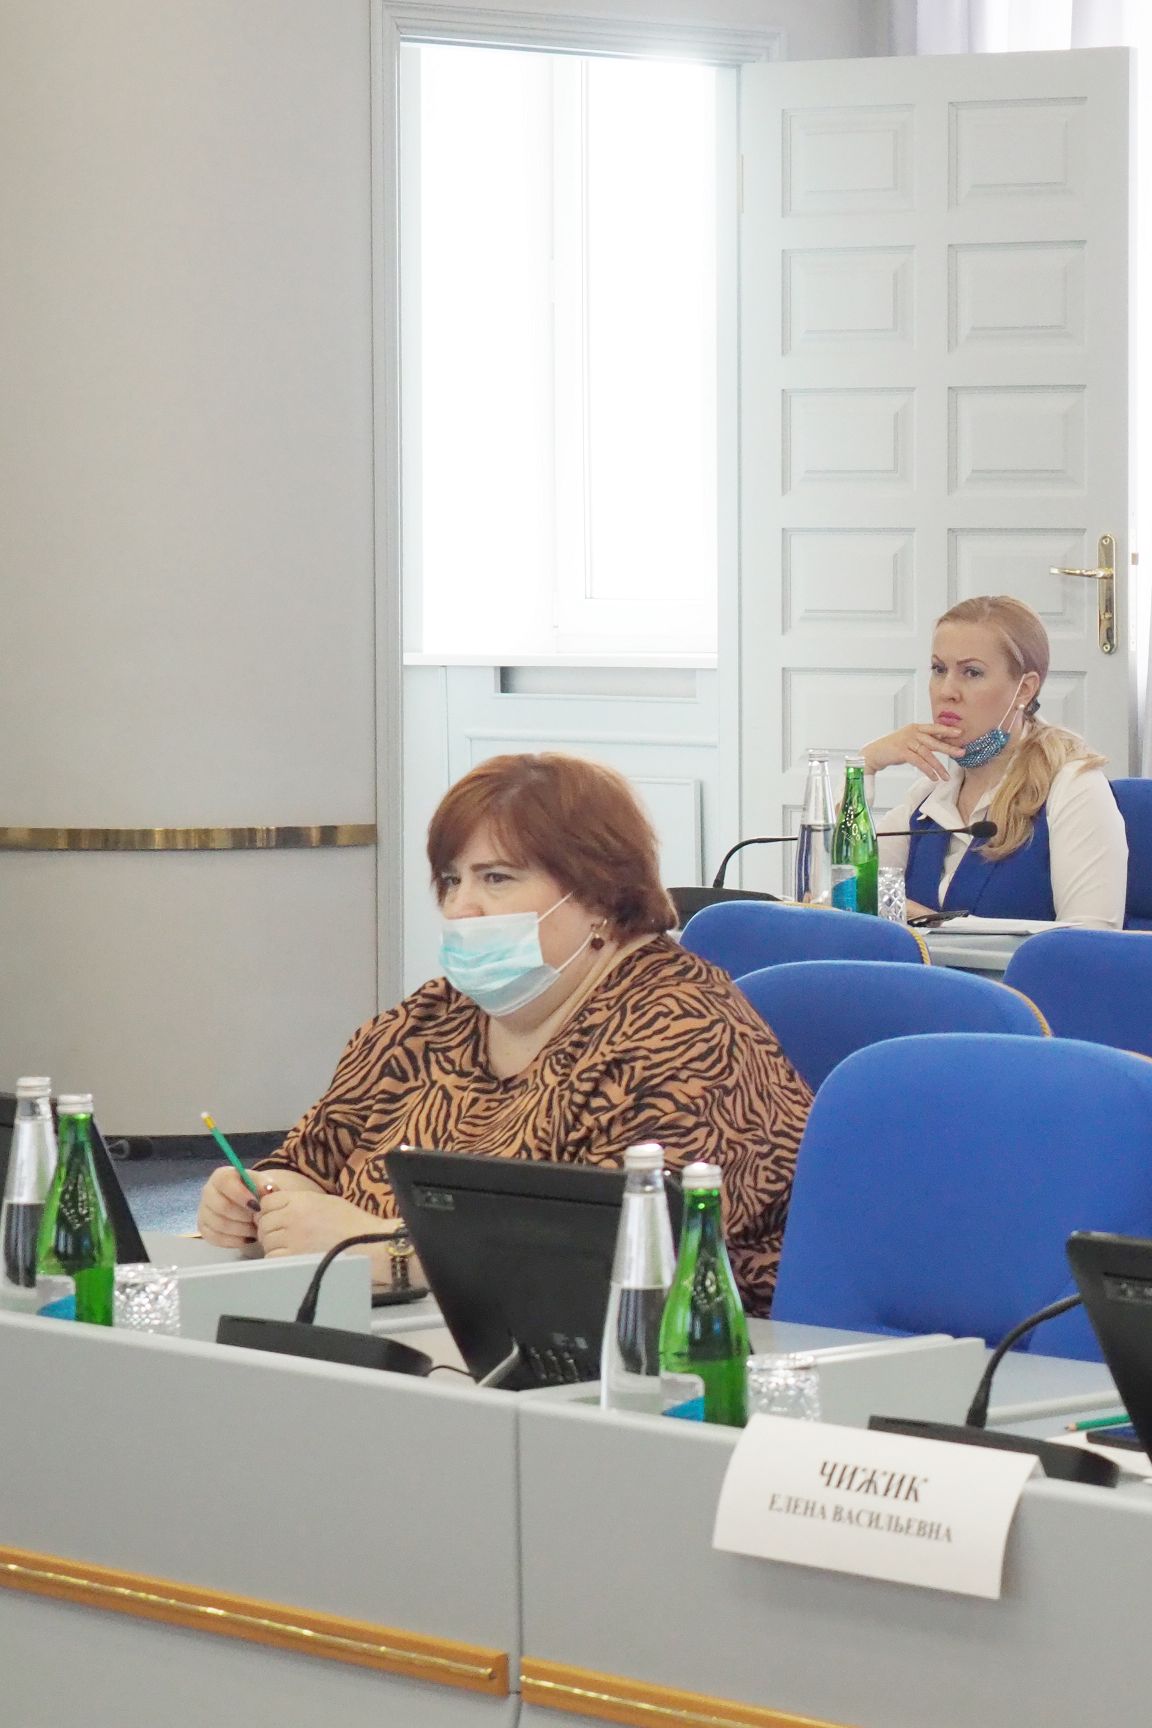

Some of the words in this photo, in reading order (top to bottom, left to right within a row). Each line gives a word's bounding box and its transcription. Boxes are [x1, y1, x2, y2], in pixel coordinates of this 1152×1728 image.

[819, 1459, 929, 1503] ЧИЖИК
[768, 1492, 828, 1521] ЕЛЕНА
[832, 1503, 953, 1544] ВАСИЛЬЕВНА
